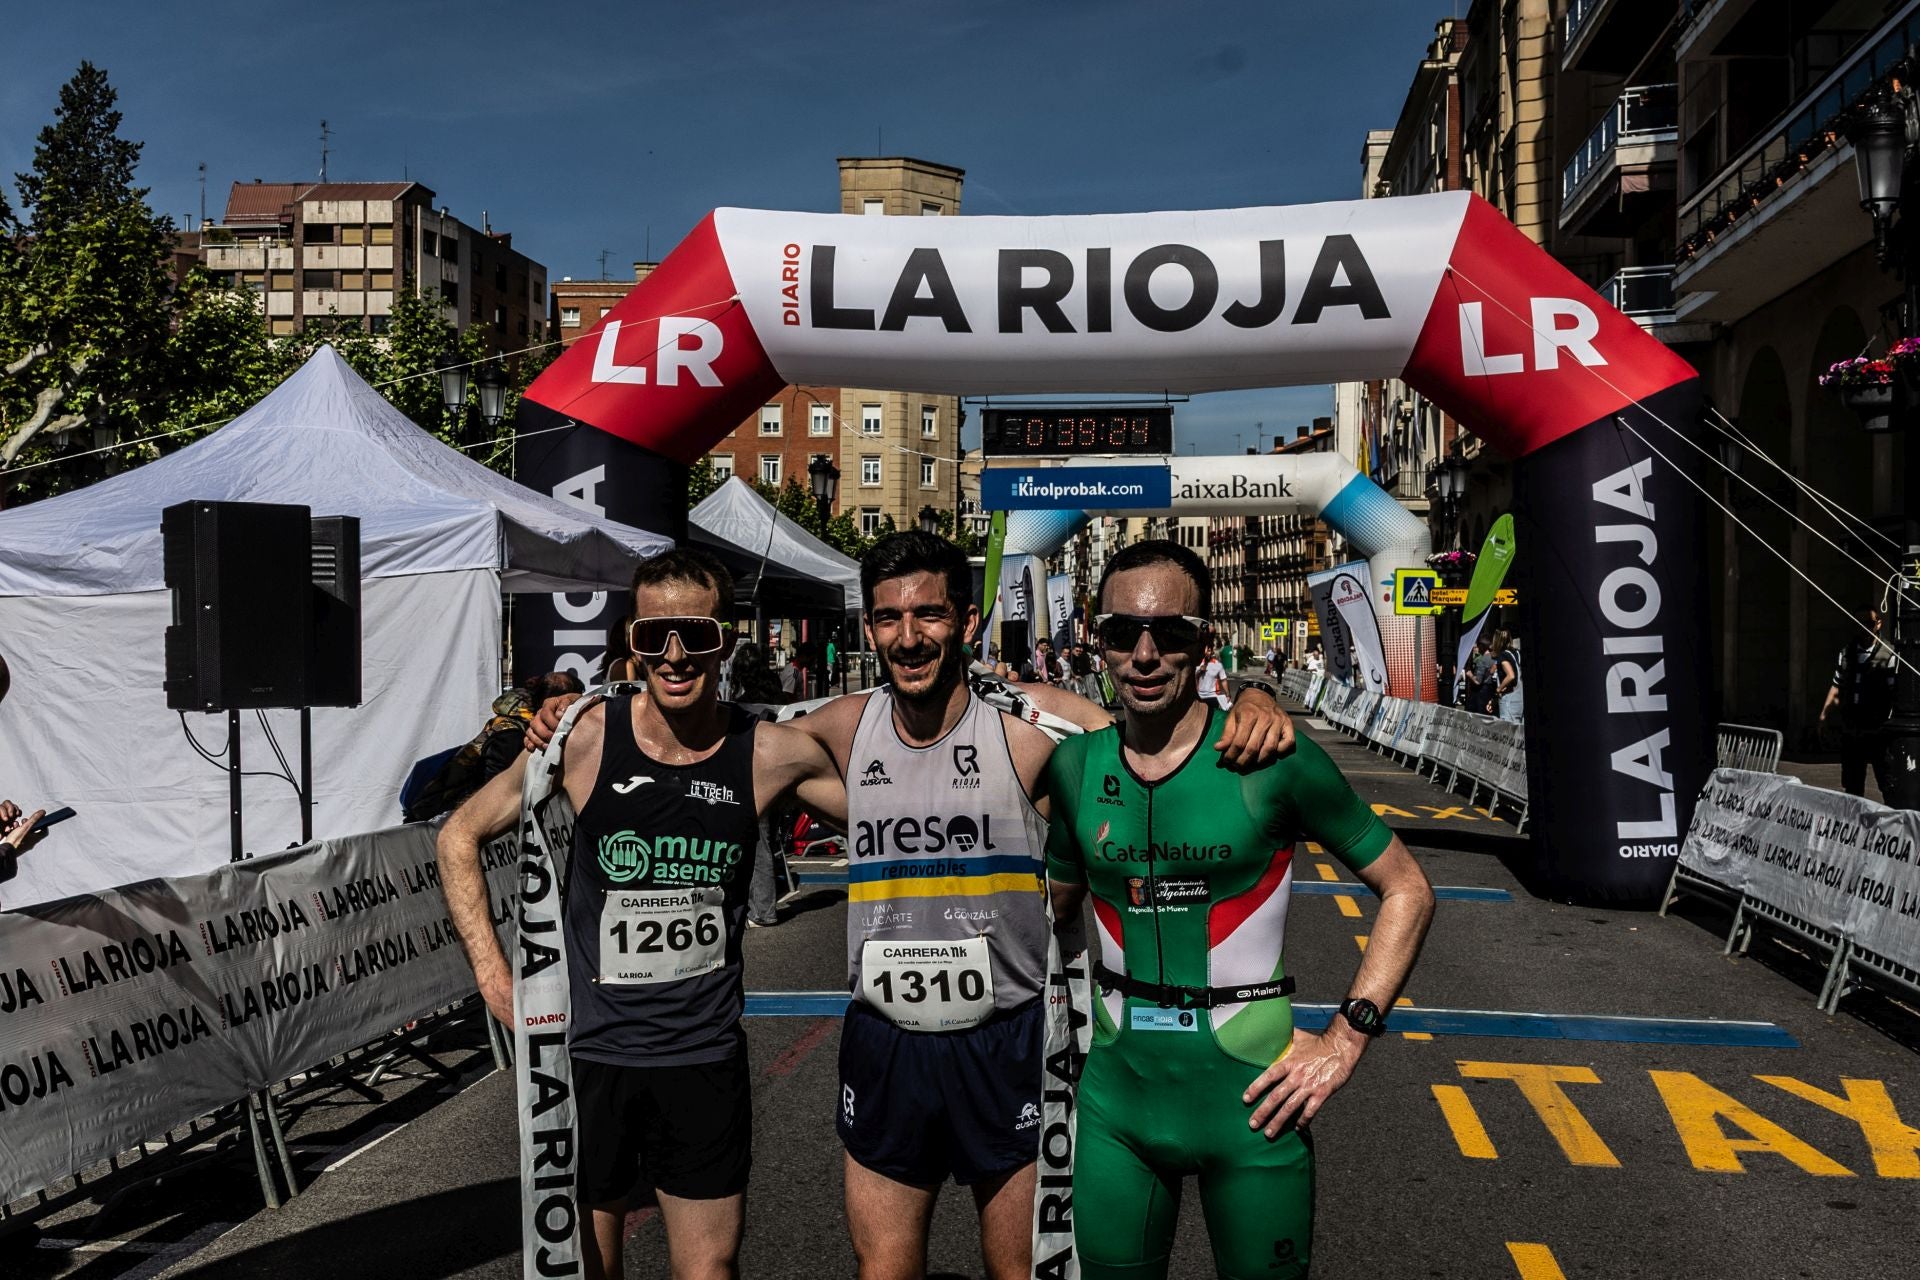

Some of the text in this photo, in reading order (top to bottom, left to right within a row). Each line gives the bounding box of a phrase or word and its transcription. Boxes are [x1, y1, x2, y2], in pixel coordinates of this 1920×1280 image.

[783, 243, 801, 326] DIARIO
[810, 233, 1391, 334] LA RIOJA
[591, 316, 724, 388] LR
[1458, 297, 1608, 378] LR
[1018, 481, 1144, 500] Kirolprobak.com
[552, 464, 608, 695] RIOA
[1592, 457, 1679, 840] LA RIOJA
[952, 777, 980, 786] RIOJA
[1369, 802, 1504, 821] AXI
[654, 835, 743, 865] muro
[1102, 840, 1232, 863] CataNatura
[1619, 842, 1679, 858] DIARIO
[881, 860, 966, 879] renovables
[621, 896, 690, 908] CARRERA
[1156, 886, 1209, 901] Agoncillo
[1157, 905, 1166, 913] Se
[1167, 905, 1189, 913] Mueve
[609, 912, 719, 954] 1266
[954, 909, 999, 921] GONZÁLE
[206, 915, 243, 954] LA
[59, 950, 110, 995] LA
[102, 929, 192, 983] RIOJA
[883, 948, 949, 958] CARRERA
[51, 960, 68, 996] DIARIO
[224, 962, 330, 1028] LA RIOJA
[873, 969, 985, 1004] 1310
[526, 1013, 566, 1026] DIARIO
[89, 1003, 212, 1076] LA RIOJA
[528, 1032, 571, 1118] LA
[1455, 1060, 1920, 1179] TAX
[532, 1127, 581, 1280] RIOJ
